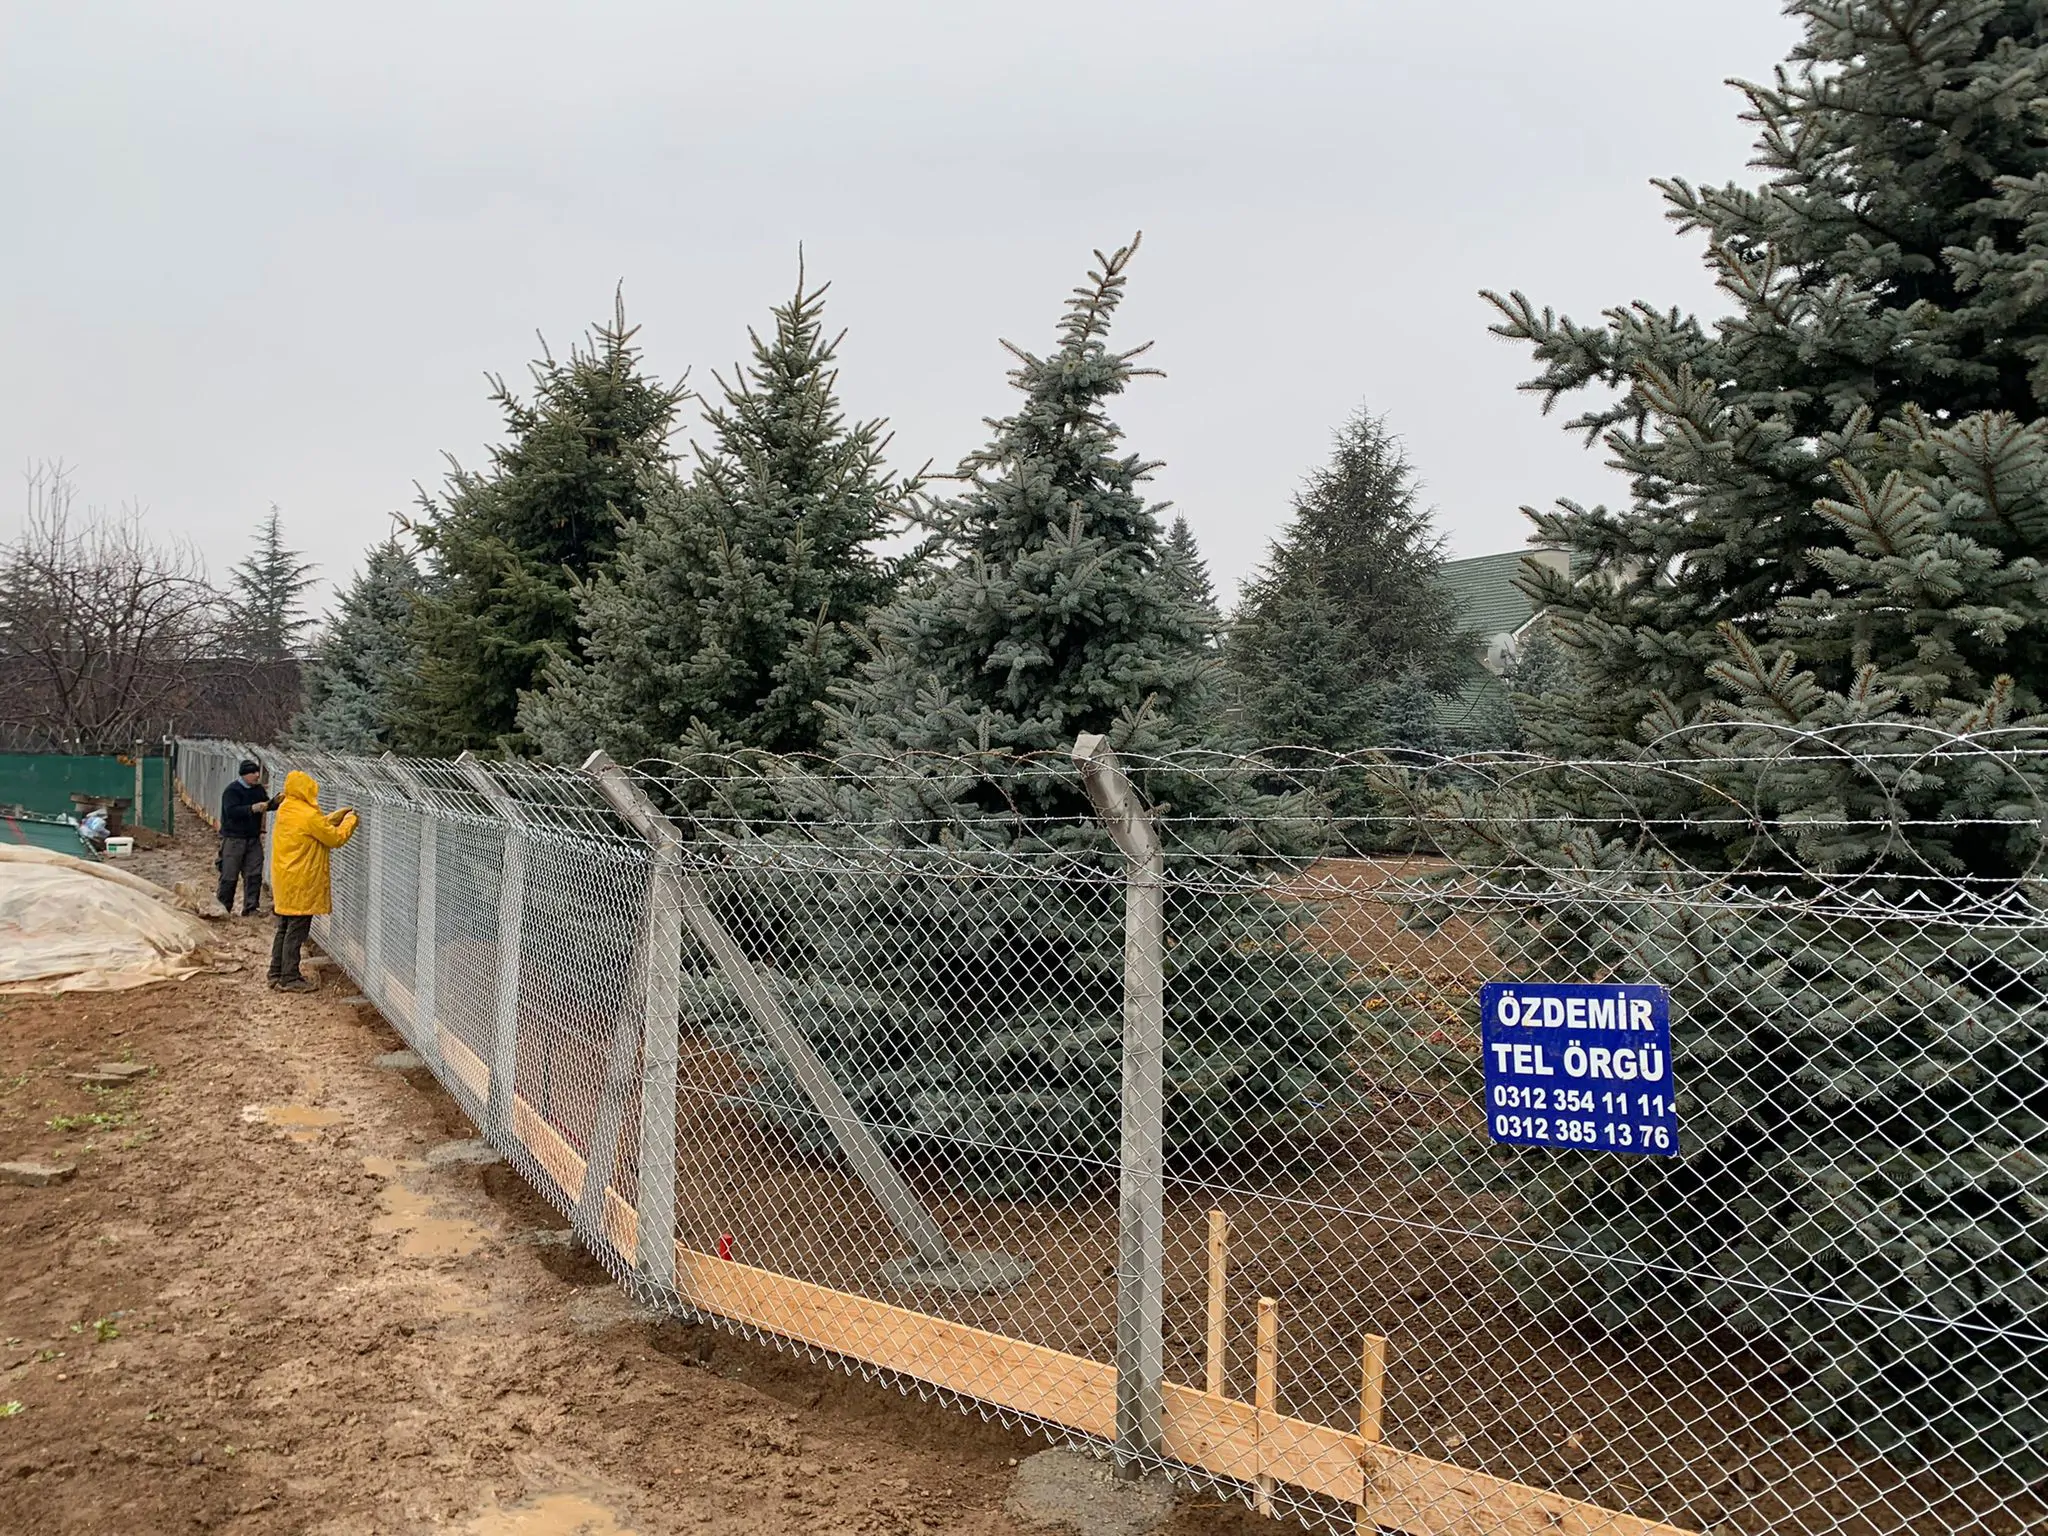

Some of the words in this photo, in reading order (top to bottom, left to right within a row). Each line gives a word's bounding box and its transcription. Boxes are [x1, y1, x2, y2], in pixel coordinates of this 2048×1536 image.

[1497, 989, 1655, 1032] ÖZDEMİR
[1491, 1043, 1554, 1076] TEL
[1563, 1039, 1664, 1082] ÖRGÜ
[1494, 1085, 1547, 1110] 0312
[1553, 1088, 1595, 1112] 354
[1602, 1091, 1628, 1115] 11
[1637, 1093, 1665, 1117] 11
[1495, 1114, 1549, 1140] 0312
[1555, 1119, 1597, 1143] 385
[1604, 1122, 1633, 1146] 13
[1638, 1125, 1670, 1149] 76
